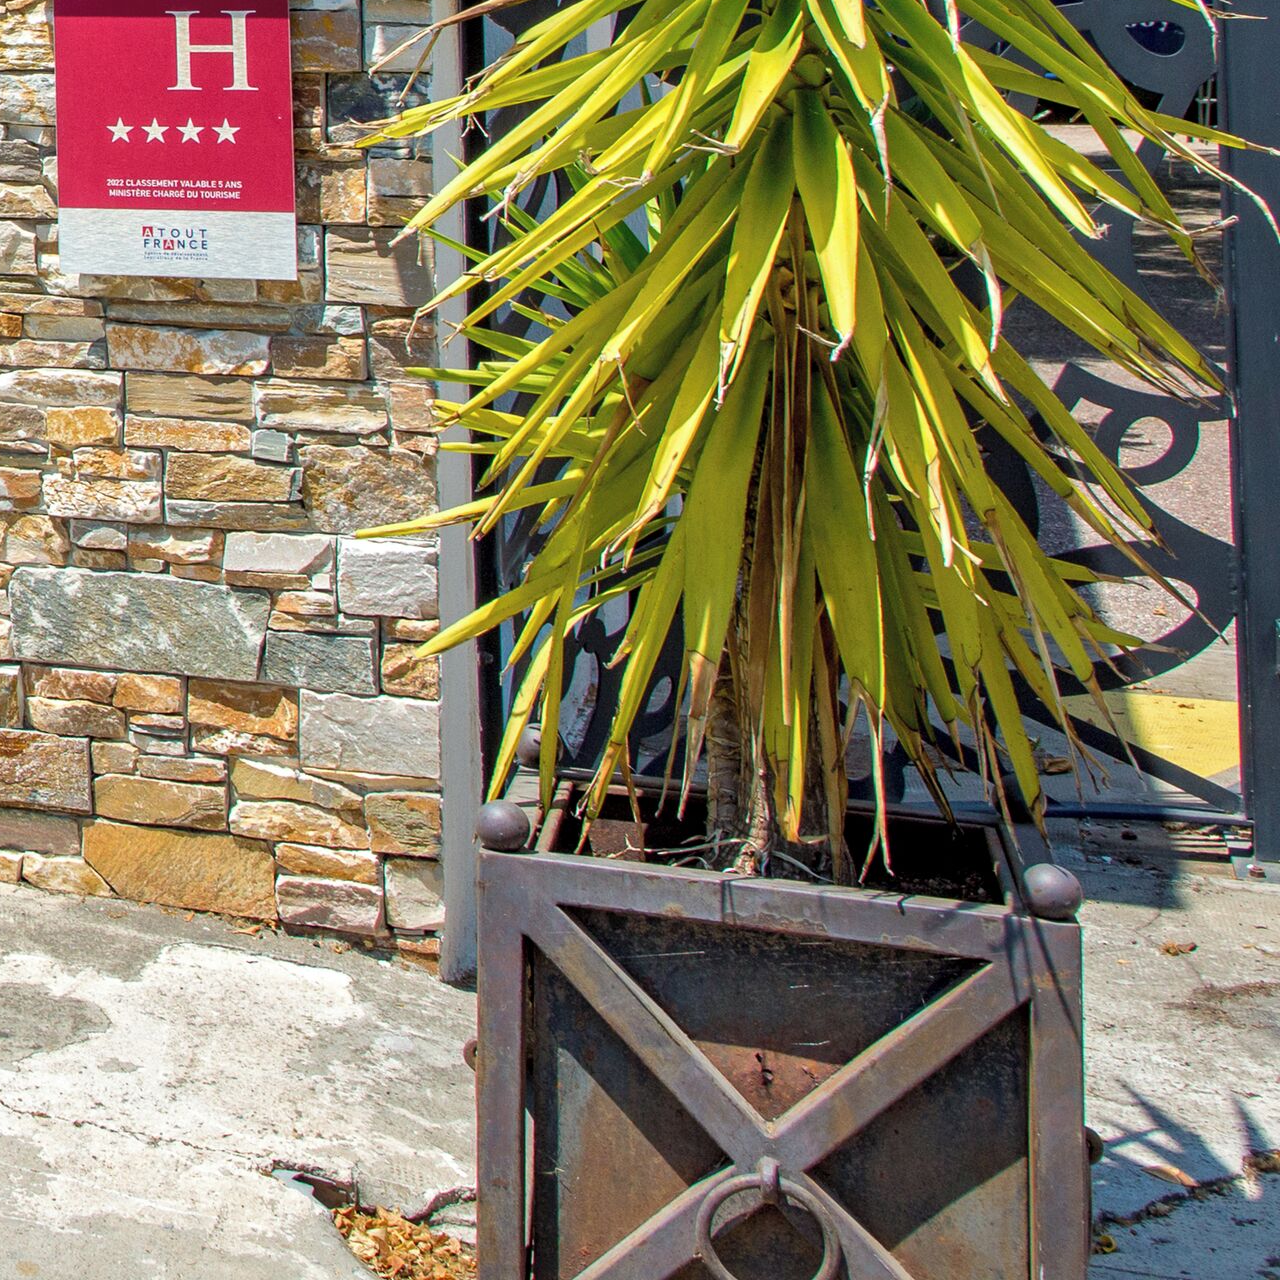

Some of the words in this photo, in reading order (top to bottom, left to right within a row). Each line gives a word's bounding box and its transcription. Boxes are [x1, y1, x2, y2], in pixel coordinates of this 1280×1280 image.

[164, 9, 260, 92] H
[106, 178, 124, 187] 2022
[126, 179, 178, 187] CLASSEMENT
[180, 180, 216, 188] VALABLE
[225, 181, 242, 189] ANS
[109, 188, 151, 197] MINISTÈRE
[152, 189, 185, 198] CHARGÉ
[200, 191, 241, 199] TOURISME
[143, 238, 208, 250] FRANCE
